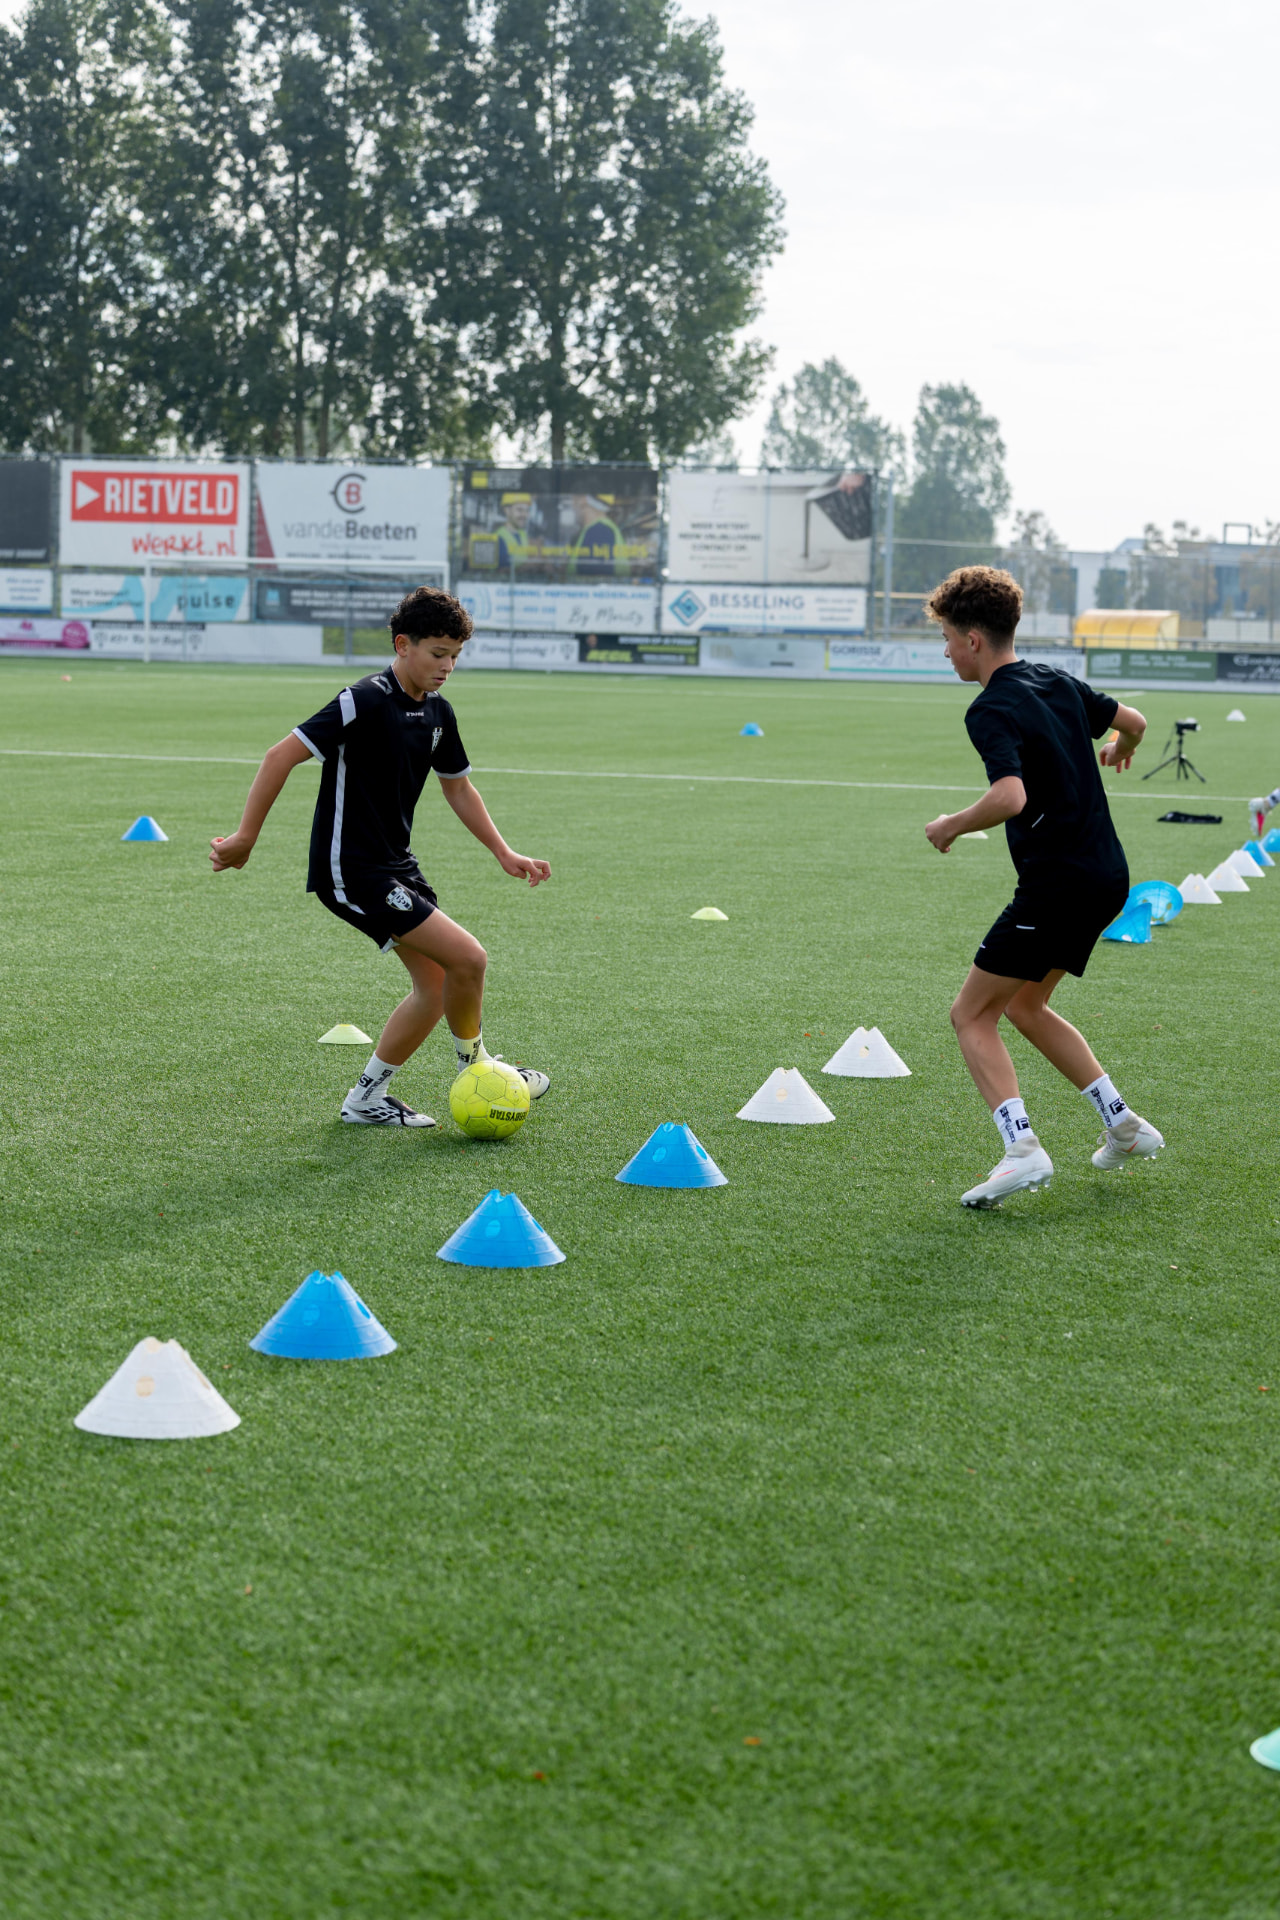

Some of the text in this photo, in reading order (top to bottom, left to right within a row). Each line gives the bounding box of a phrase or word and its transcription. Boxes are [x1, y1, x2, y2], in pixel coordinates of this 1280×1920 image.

[104, 477, 234, 516] RIETVELD
[283, 519, 417, 541] vandeBeeten
[132, 529, 237, 556] werkt.nl
[177, 590, 235, 612] pulse
[709, 593, 805, 610] BESSELING
[831, 646, 881, 656] GORISSE
